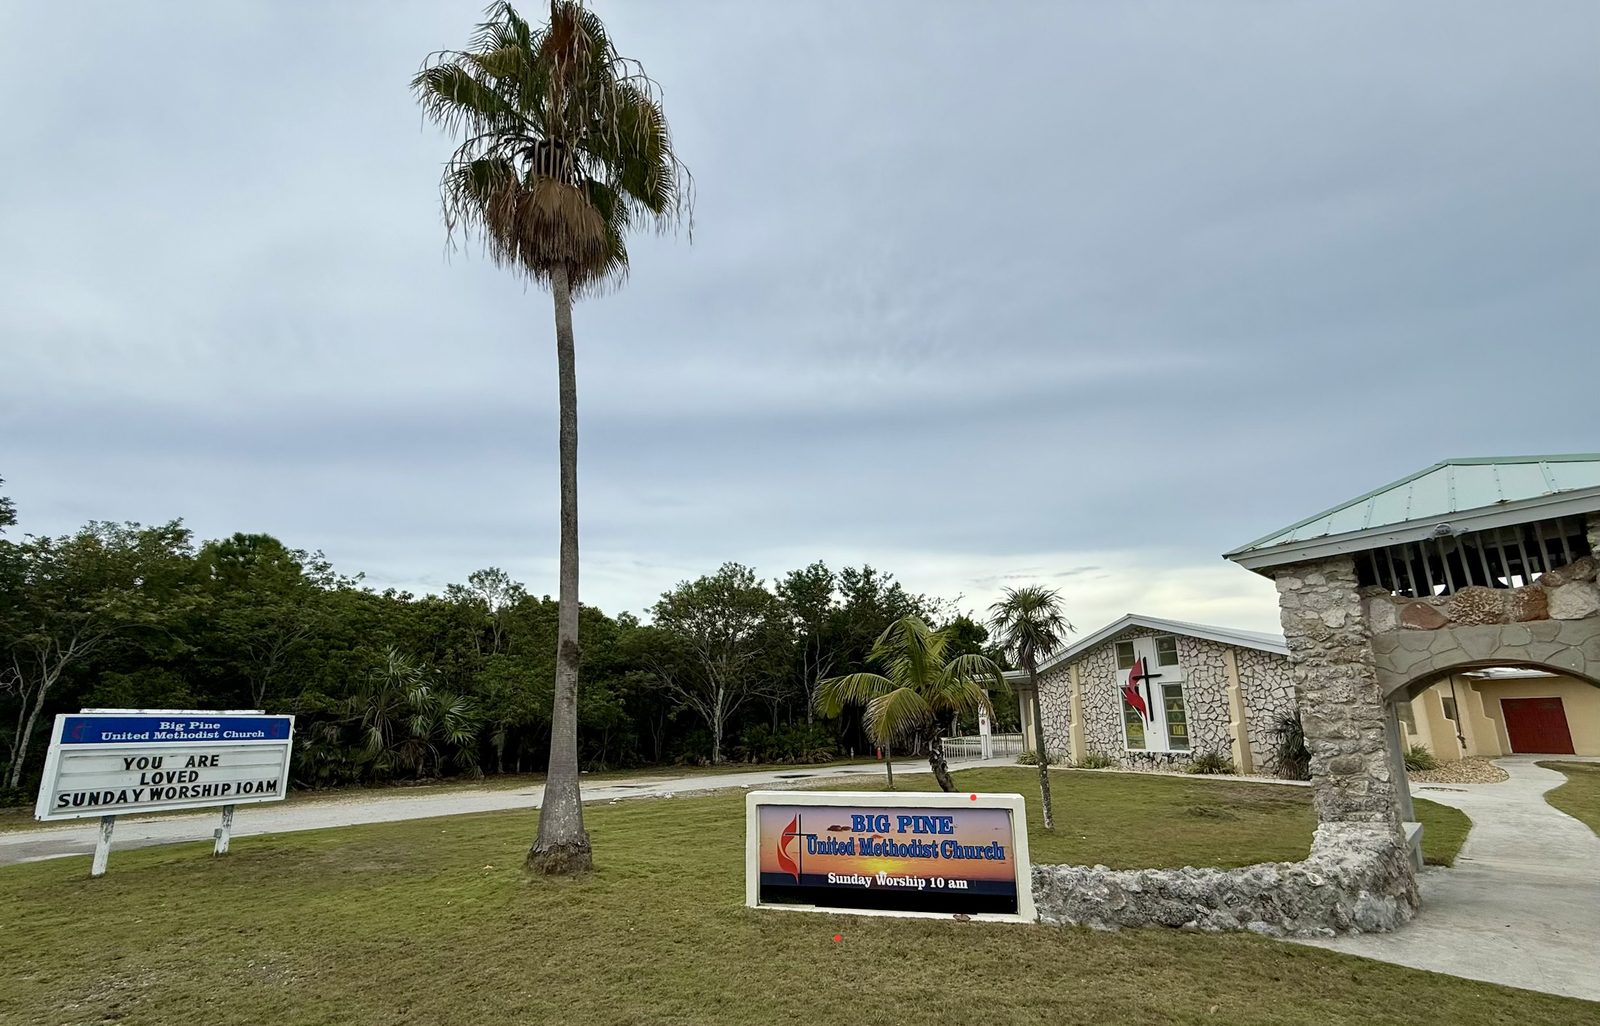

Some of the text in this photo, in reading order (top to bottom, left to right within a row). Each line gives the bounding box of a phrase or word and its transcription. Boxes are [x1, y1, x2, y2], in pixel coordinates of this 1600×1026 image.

[159, 721, 220, 731] Big Pine
[101, 730, 265, 740] United Methodist Church
[124, 755, 219, 770] YOU ARE
[140, 771, 199, 785] LOVED
[58, 788, 144, 807] SUNDAY
[150, 783, 231, 800] WORSHIP
[851, 814, 954, 834] BIG PINE
[806, 835, 1005, 860] United Methodist Church
[828, 873, 968, 890] Sunday Worship 10 am
